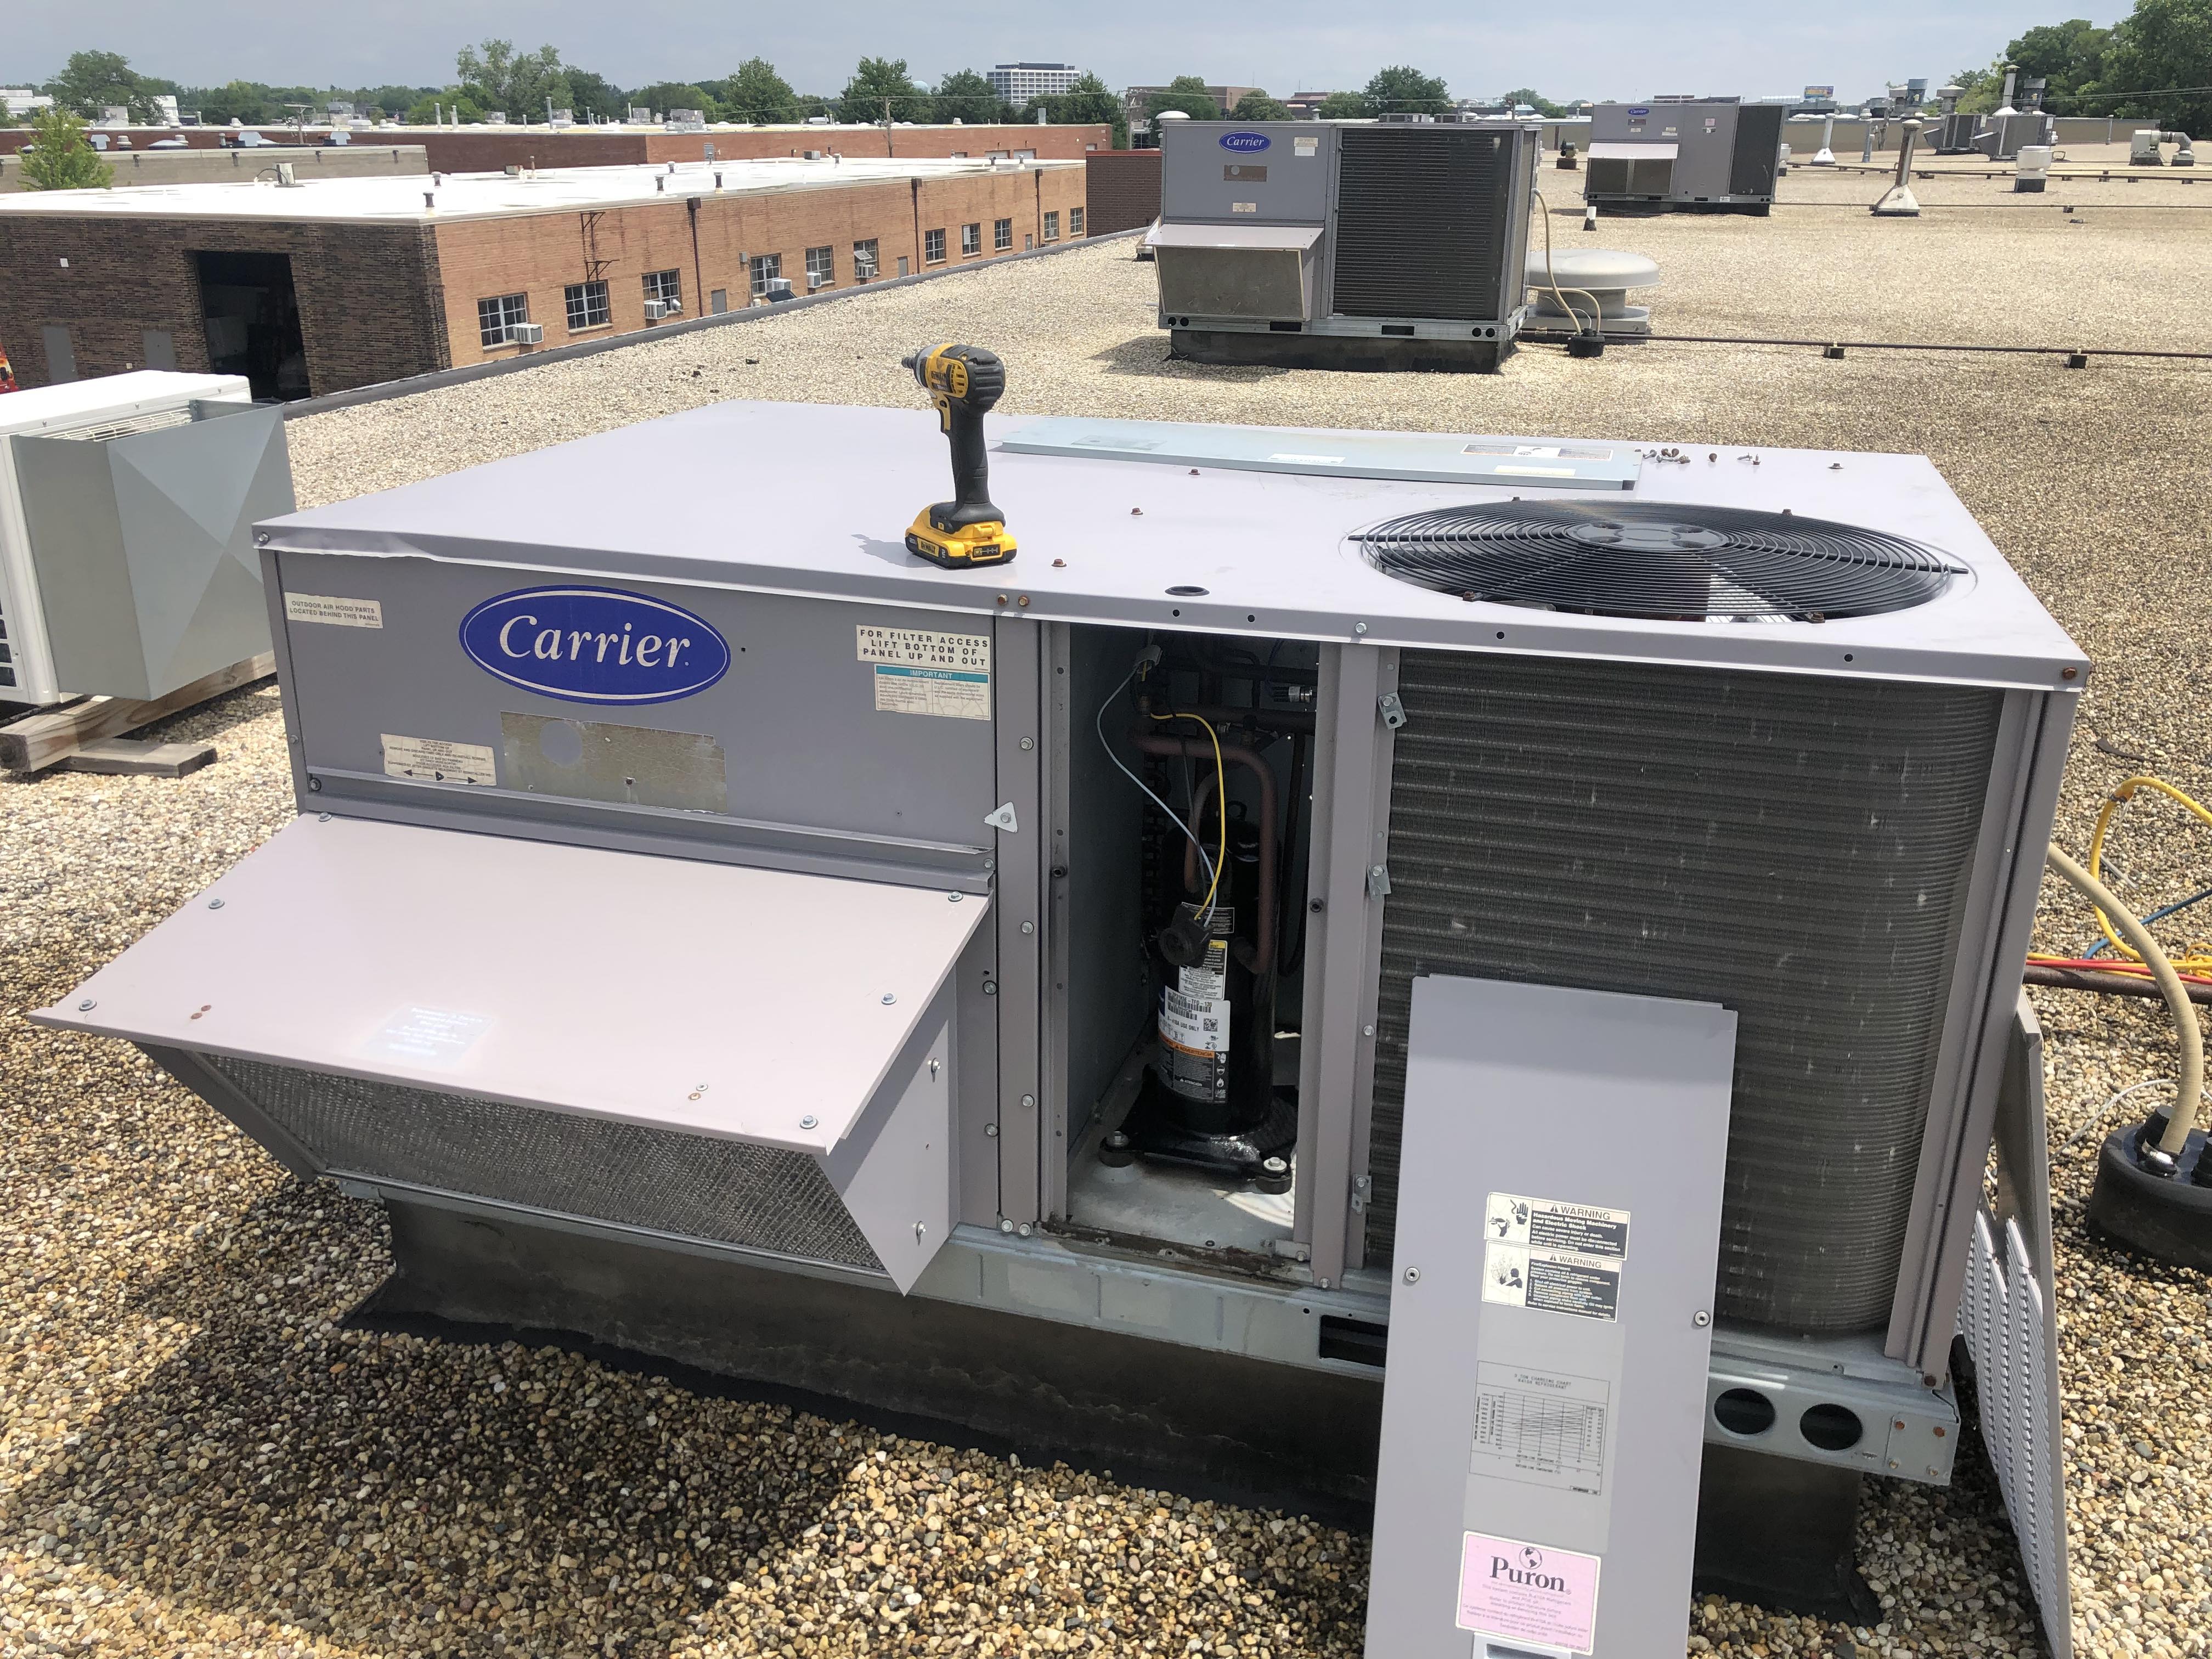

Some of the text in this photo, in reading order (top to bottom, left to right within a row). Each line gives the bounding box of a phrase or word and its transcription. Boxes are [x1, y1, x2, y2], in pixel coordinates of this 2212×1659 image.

[1227, 136, 1265, 146] Carrier
[292, 600, 322, 608] OUTDOOR
[499, 615, 690, 668] Carrier
[860, 629, 988, 647] FOR FILTER ACCESS
[871, 640, 897, 648] LIFT
[905, 643, 955, 654] BOTTOM
[863, 648, 901, 658] PANEL
[930, 654, 954, 663] AND
[962, 657, 986, 666] OUT
[910, 669, 953, 680] IMPORTANT
[1533, 1212, 1563, 1221] Hazardous
[1587, 1221, 1616, 1229] Machinery
[1561, 1205, 1610, 1221] WARNING
[1559, 1255, 1601, 1268] WARNING
[1489, 1555, 1565, 1592] Puron
